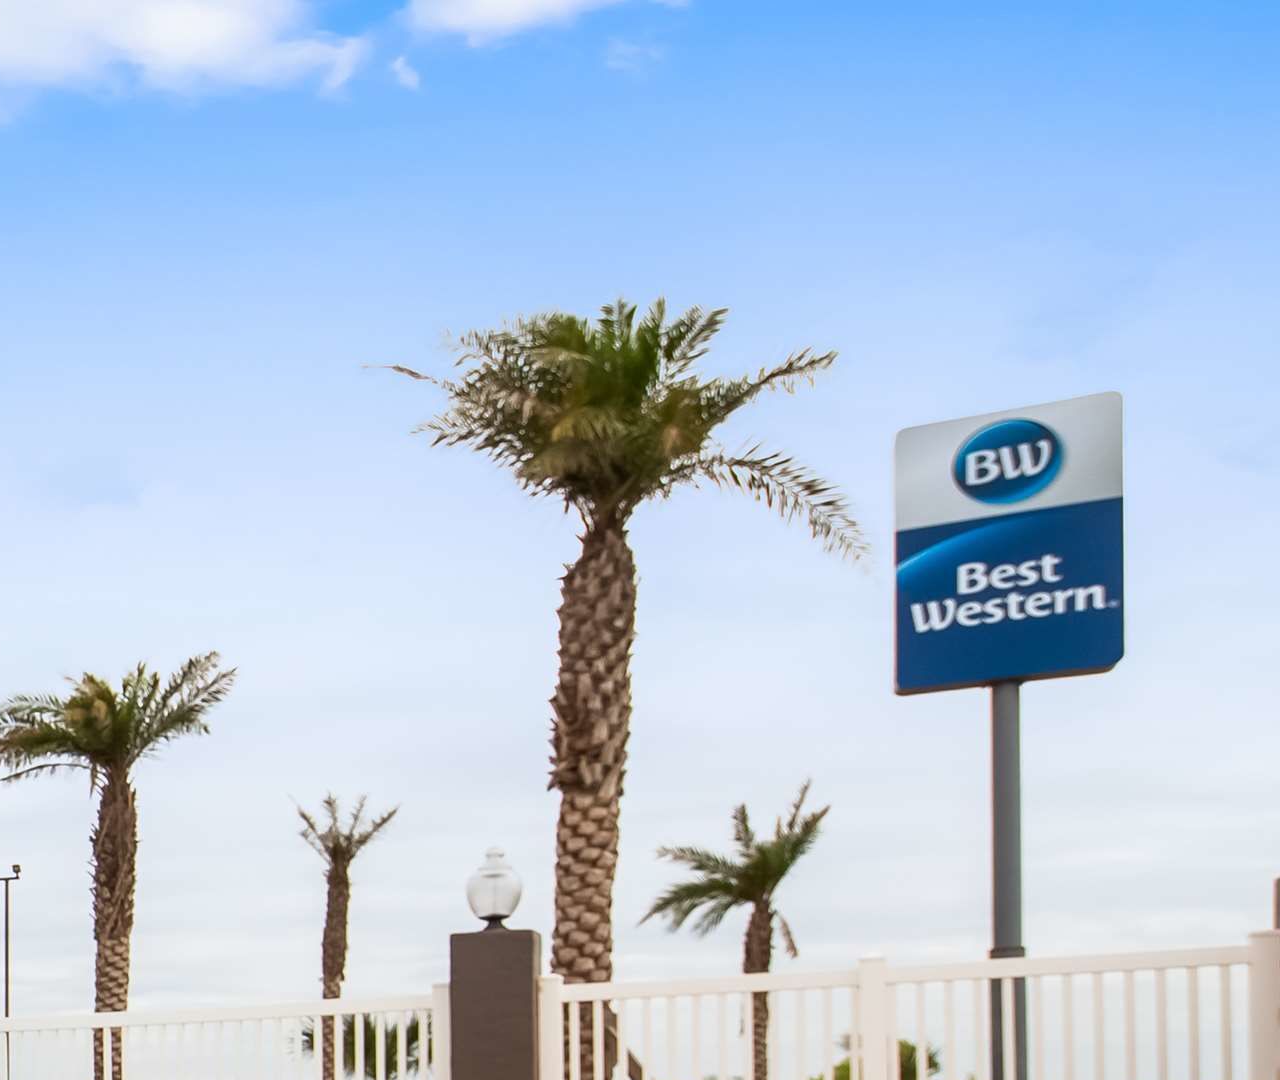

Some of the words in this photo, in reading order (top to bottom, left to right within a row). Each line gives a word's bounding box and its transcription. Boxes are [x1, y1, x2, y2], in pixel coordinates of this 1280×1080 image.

[964, 438, 1054, 487] BW
[956, 554, 1063, 595] Best
[911, 584, 1108, 634] Western
